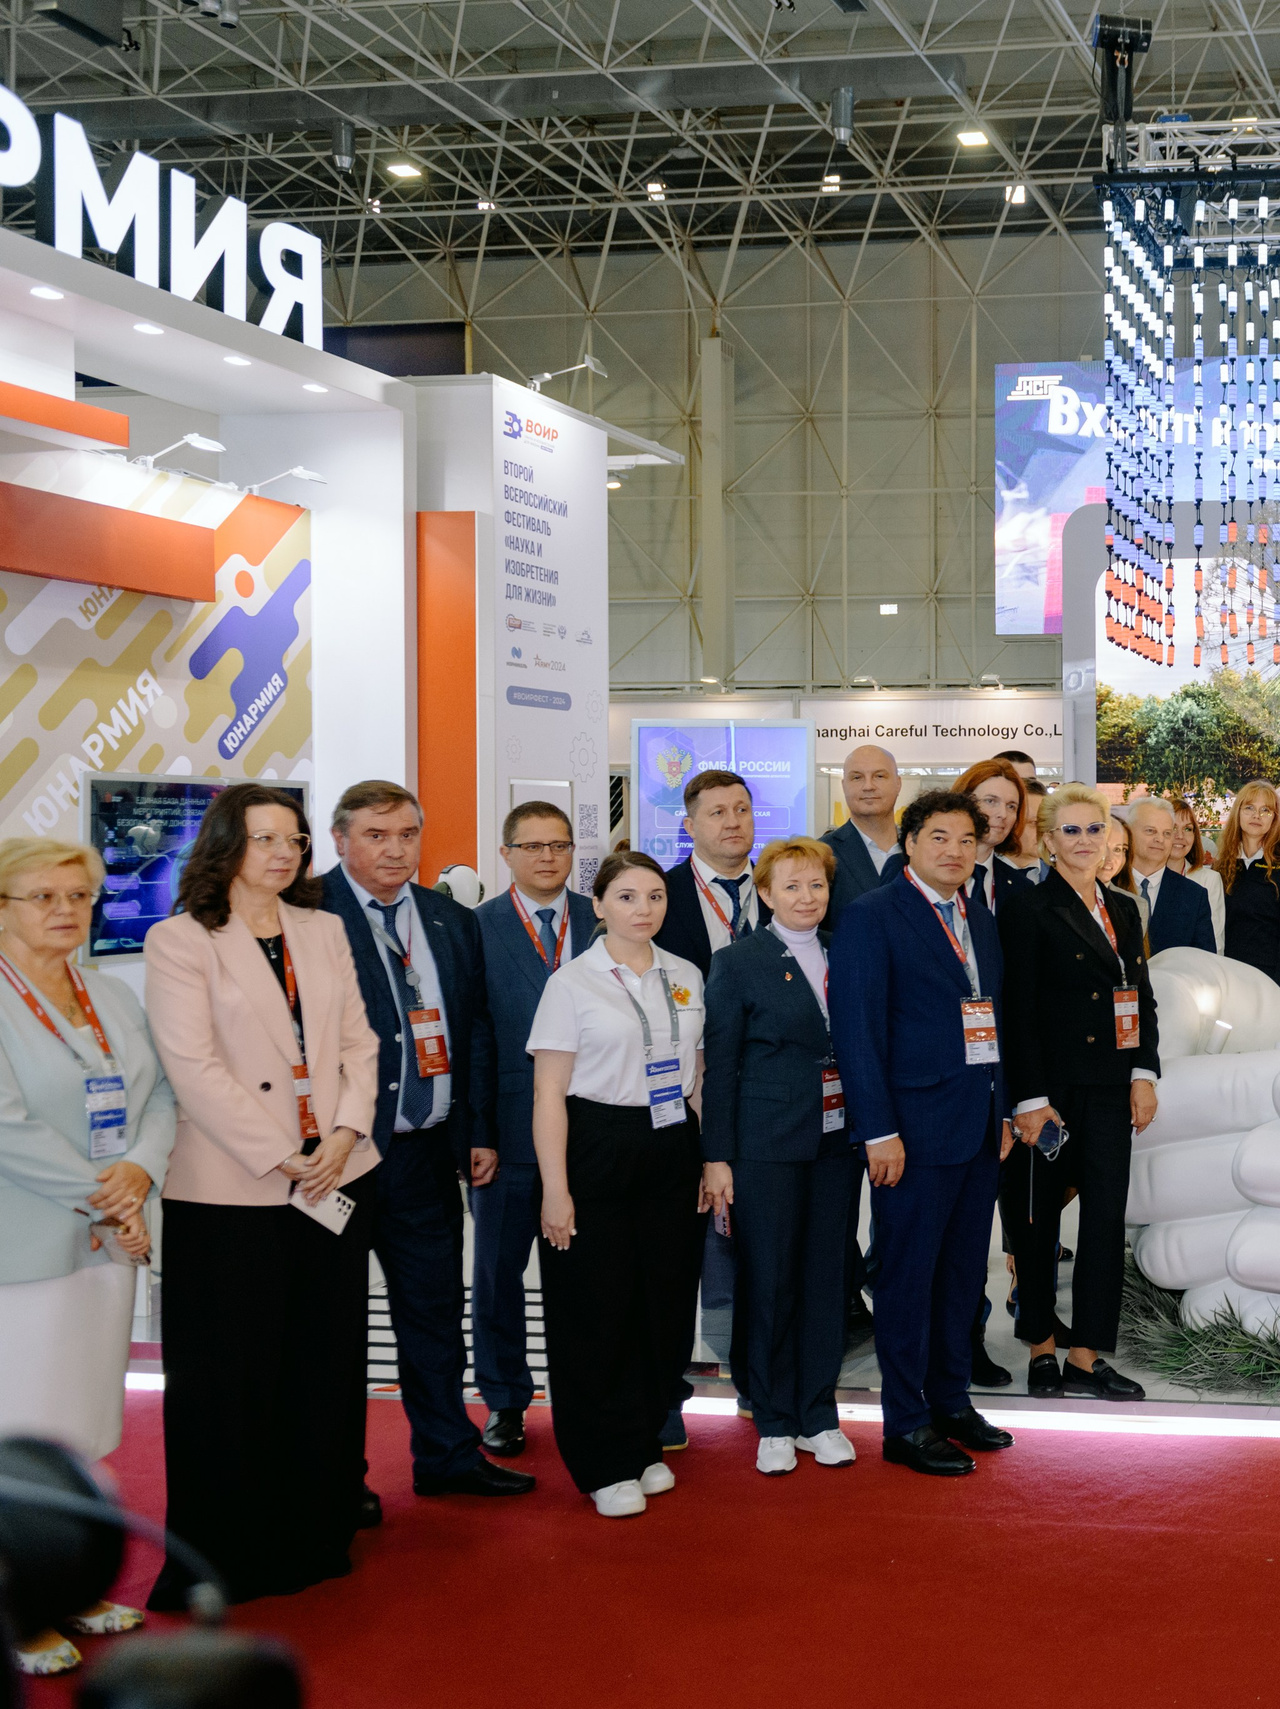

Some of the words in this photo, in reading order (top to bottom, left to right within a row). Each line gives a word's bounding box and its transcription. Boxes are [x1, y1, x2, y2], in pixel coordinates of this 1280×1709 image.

[525, 419, 559, 441] ВОИР
[504, 460, 534, 483] ВТОРОЙ
[504, 484, 568, 518] ВСЕРОССИЙСКИЙ
[504, 510, 552, 536] ФЕСТИВАЛЬ
[504, 535, 536, 556] «НАУКА
[537, 543, 543, 558] И
[505, 558, 559, 585] ИЗОБРЕТЕНИЯ
[505, 583, 523, 601] ДЛЯ
[524, 587, 557, 607] ЖИЗНИ»
[222, 672, 285, 753] ЮНАРМИЯ
[875, 724, 928, 738] Careful
[932, 724, 1018, 740] Technology
[22, 669, 164, 837] ЮНАРМИЯ
[698, 760, 736, 772] ФМБА
[739, 760, 791, 773] РОССИИ
